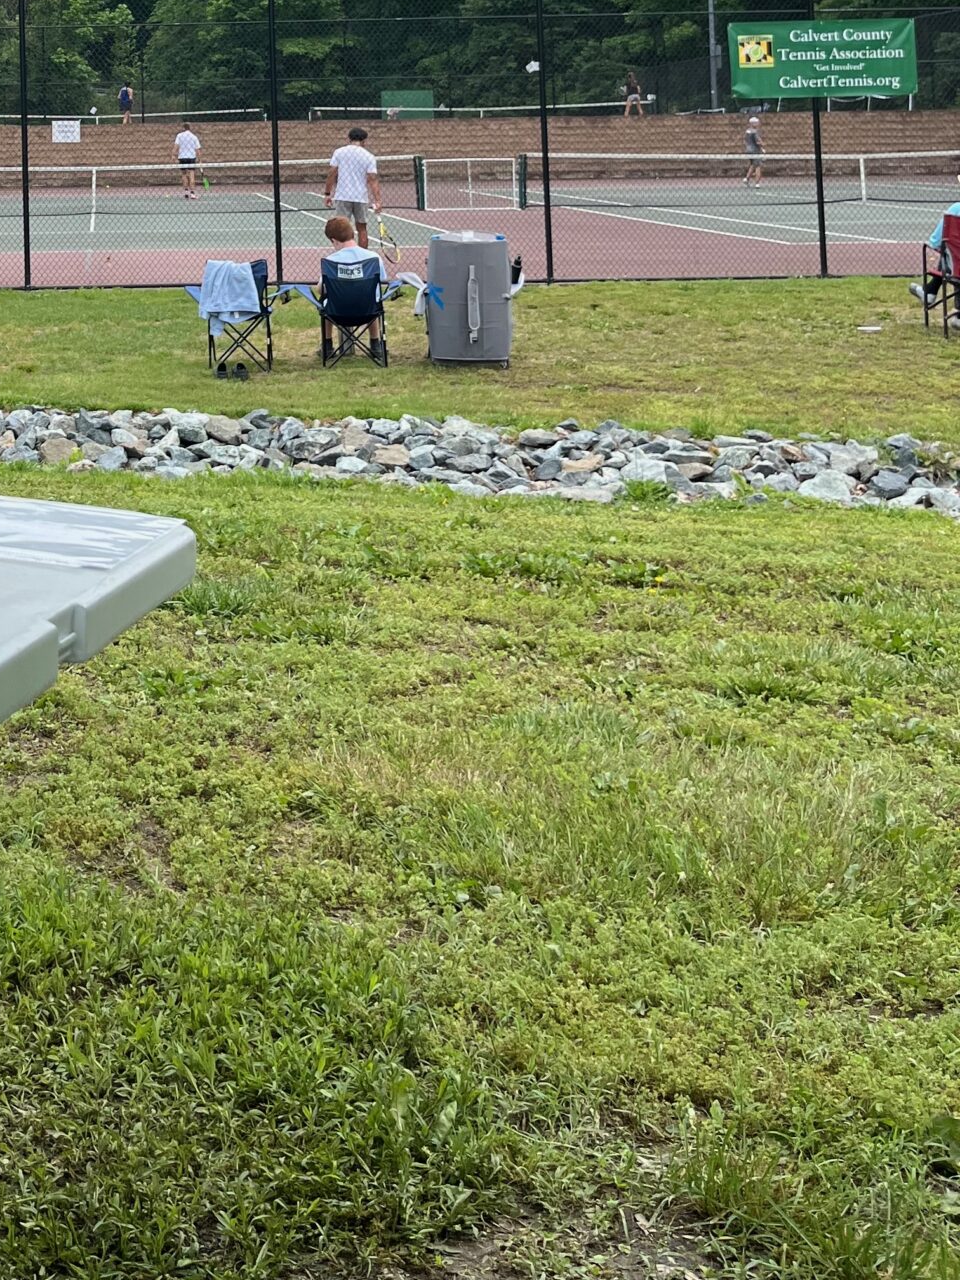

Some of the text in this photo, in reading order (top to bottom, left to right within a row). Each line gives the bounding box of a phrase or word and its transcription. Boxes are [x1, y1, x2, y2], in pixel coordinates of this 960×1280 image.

[789, 29, 839, 42] Calvert
[842, 28, 893, 44] County
[776, 46, 904, 61] Tennis Association
[779, 74, 901, 90] CalvertTennis.org
[339, 266, 362, 276] DICK'S
